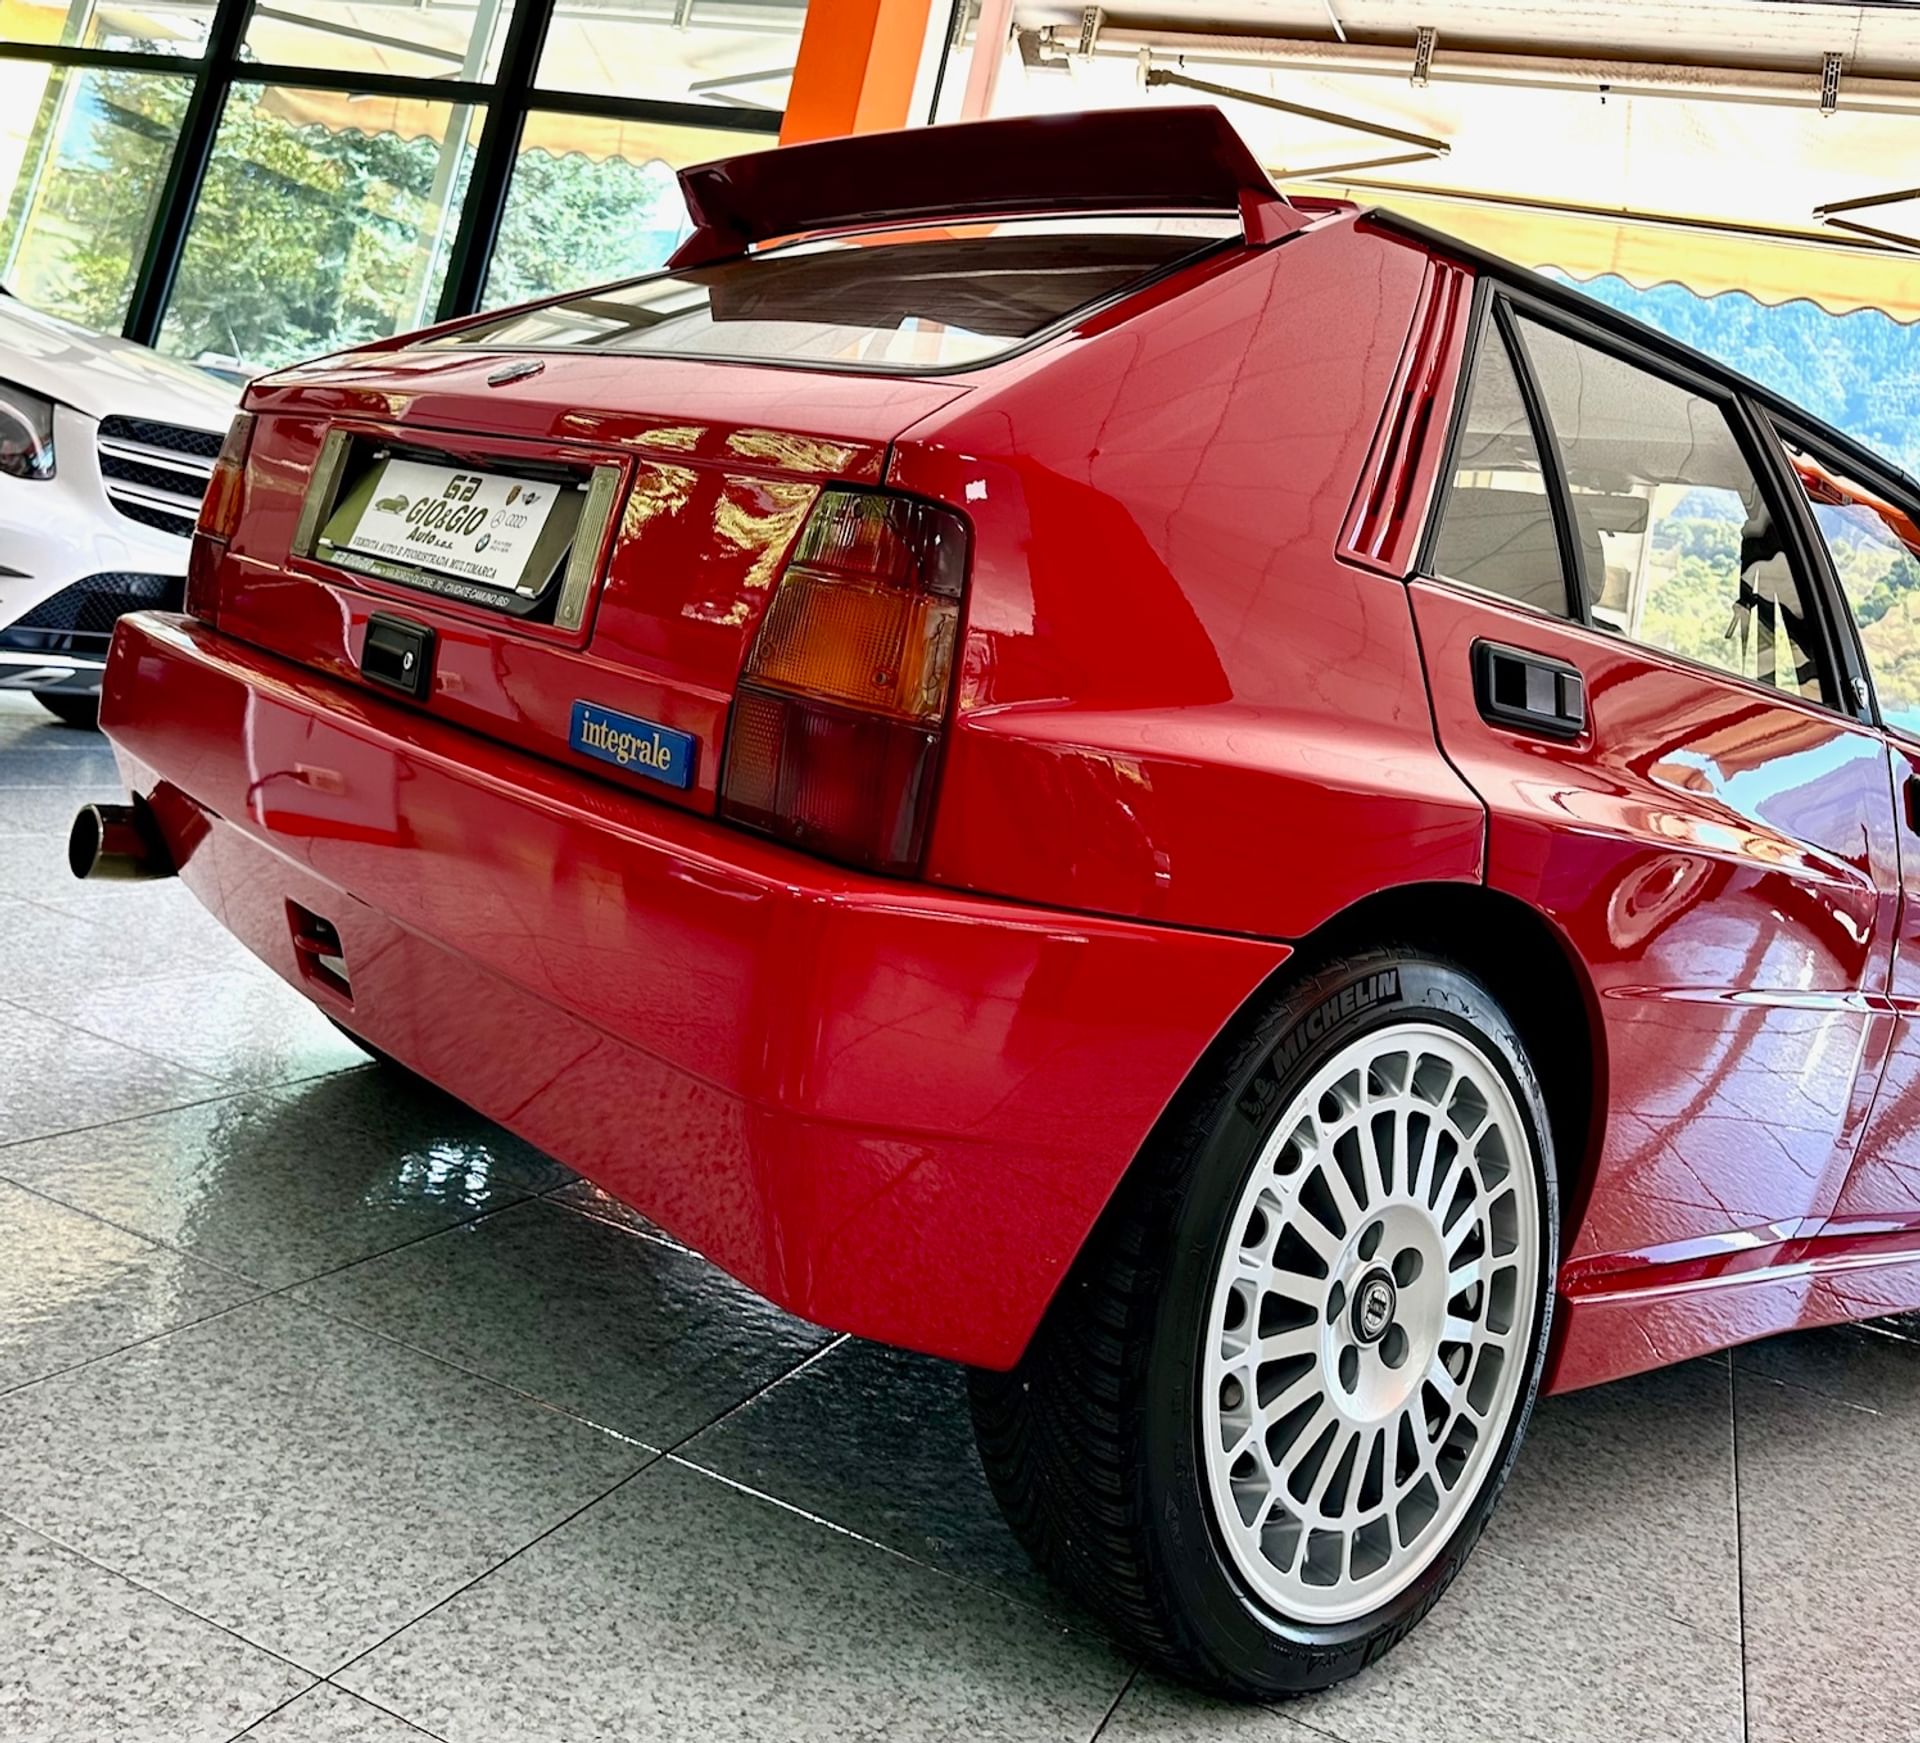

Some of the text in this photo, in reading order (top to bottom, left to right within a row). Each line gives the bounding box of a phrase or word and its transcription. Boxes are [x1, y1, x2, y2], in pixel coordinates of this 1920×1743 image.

[405, 497, 489, 536] GIO&GIO
[406, 526, 437, 547] Auto
[379, 543, 398, 556] AUTO
[402, 547, 450, 569] FUORISTRADA
[449, 558, 497, 579] MULTIMARCA
[581, 710, 671, 770] integrale
[1273, 969, 1398, 1080] MICHELIN
